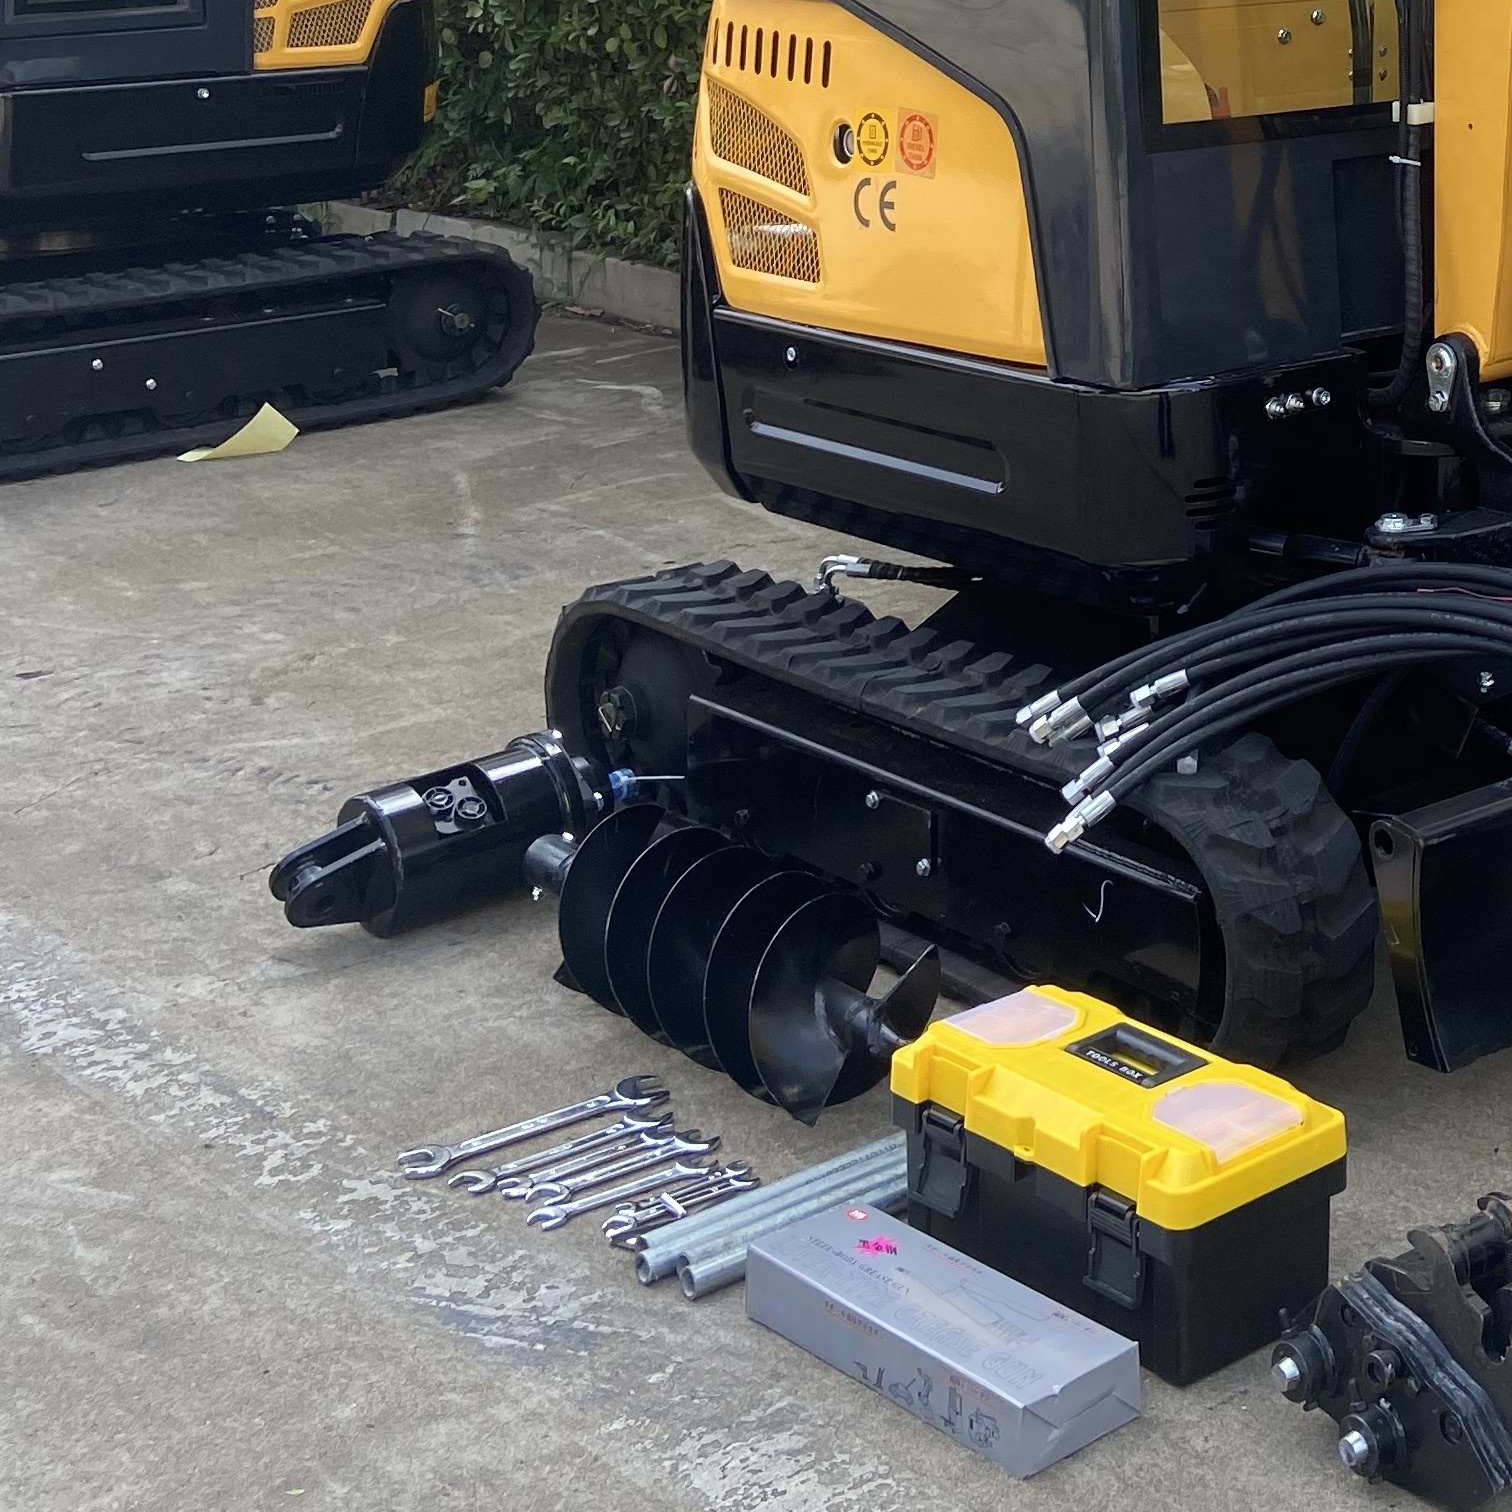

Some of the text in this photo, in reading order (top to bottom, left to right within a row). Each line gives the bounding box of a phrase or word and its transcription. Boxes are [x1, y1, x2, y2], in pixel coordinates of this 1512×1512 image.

[854, 177, 897, 232] CE
[1086, 1050, 1143, 1079] TOOLS BOX
